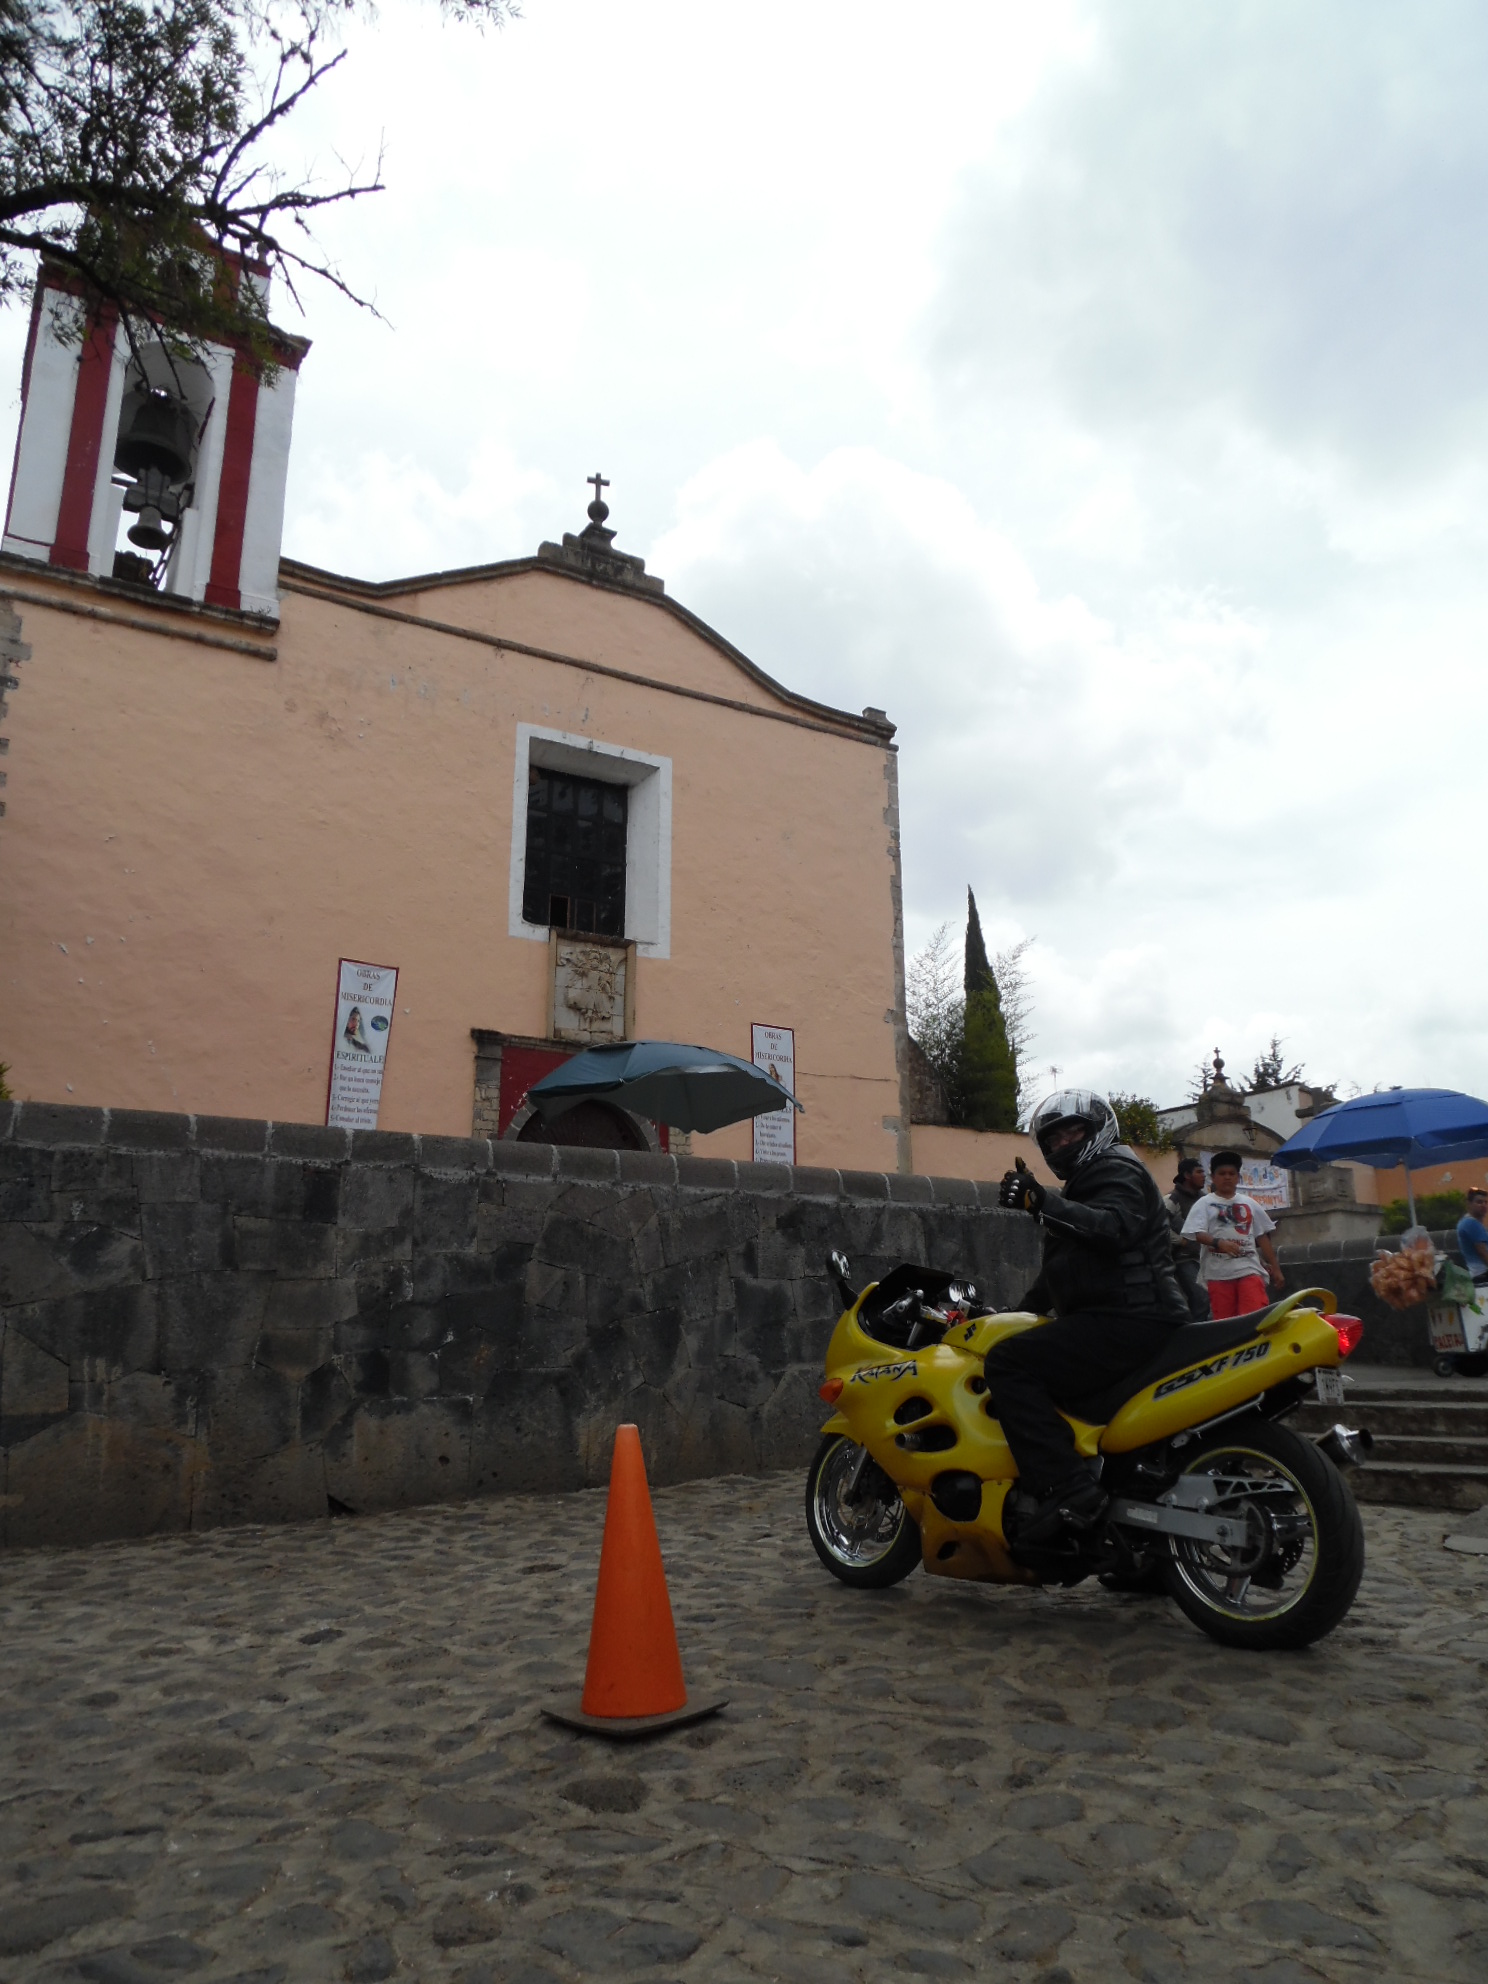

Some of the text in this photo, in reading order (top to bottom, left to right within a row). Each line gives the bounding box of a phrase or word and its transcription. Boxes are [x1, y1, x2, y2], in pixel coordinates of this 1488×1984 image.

[357, 969, 380, 980] OBRAS
[363, 983, 372, 991] DE
[341, 992, 392, 1006] MISERICORDIA
[337, 1051, 383, 1063] ESPIRITUALE
[1231, 1340, 1271, 1367] 750
